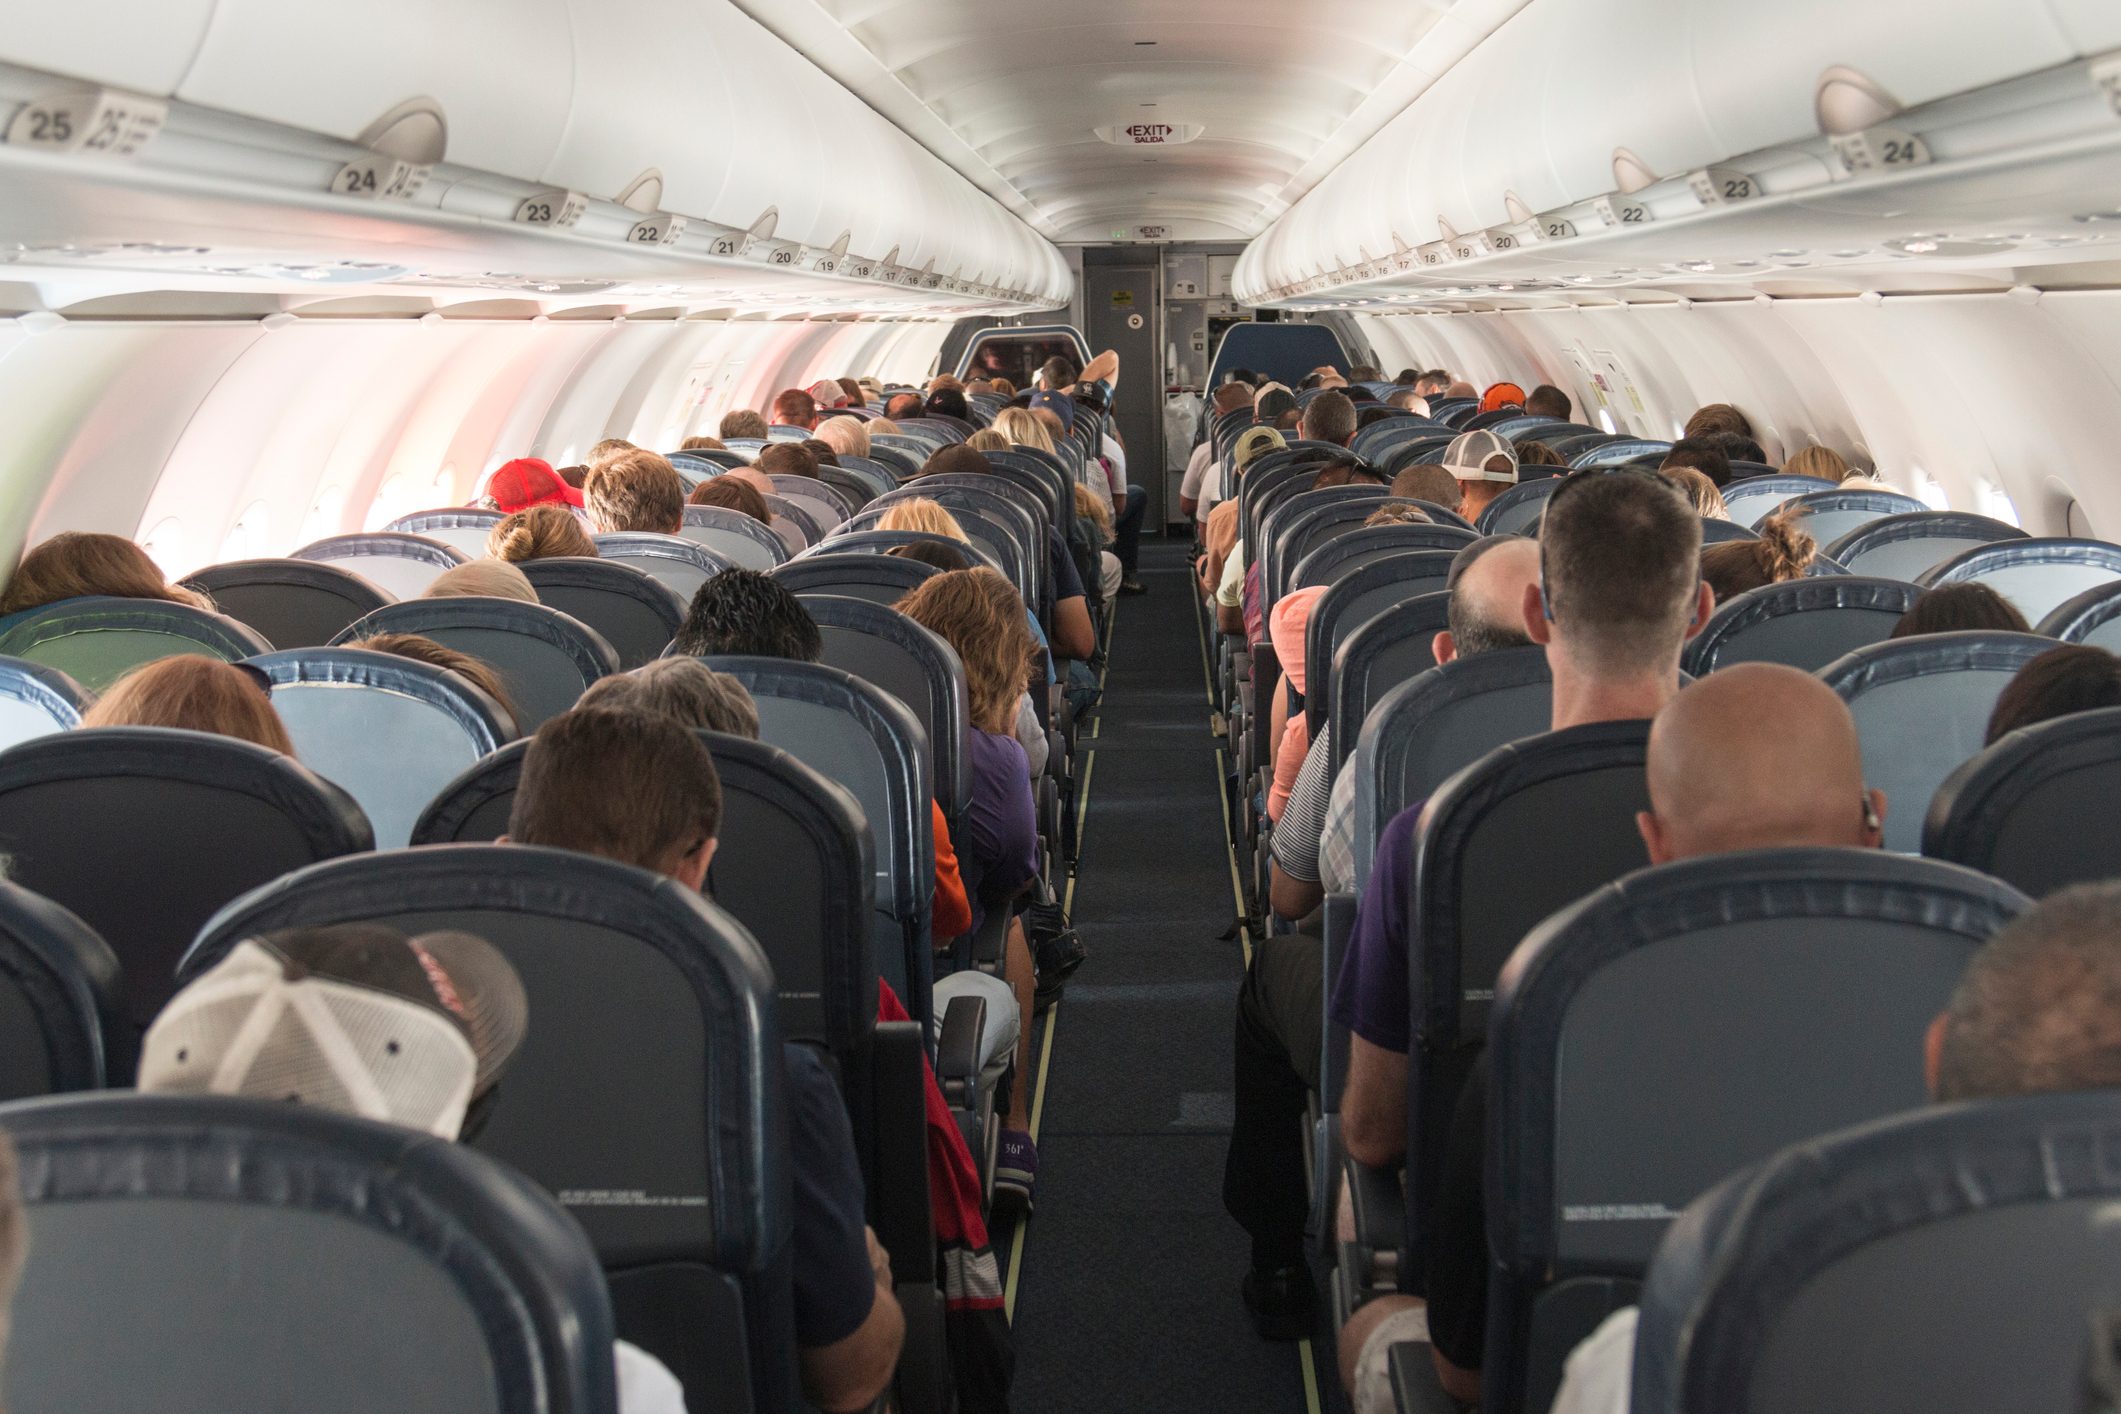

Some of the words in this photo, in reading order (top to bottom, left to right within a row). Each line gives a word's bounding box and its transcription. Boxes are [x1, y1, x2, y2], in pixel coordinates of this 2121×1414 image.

[30, 110, 72, 141] 25
[1133, 125, 1165, 136] EXIT
[1883, 141, 1915, 164] 24
[347, 168, 376, 191] 24
[1725, 180, 1750, 198] 23
[526, 203, 551, 221] 23
[1622, 207, 1643, 222] 22
[637, 227, 658, 241] 22
[1549, 224, 1566, 236] 21
[718, 241, 734, 254] 21
[1495, 237, 1511, 248] 20
[776, 252, 791, 263] 20
[1457, 248, 1470, 258] 19
[1399, 260, 1409, 269] 17
[1424, 254, 1436, 264] 18
[821, 261, 834, 271] 19
[857, 266, 869, 276] 18
[1378, 267, 1388, 275] 16
[885, 272, 896, 280] 17
[1360, 270, 1369, 278] 15
[928, 279, 938, 287] 15
